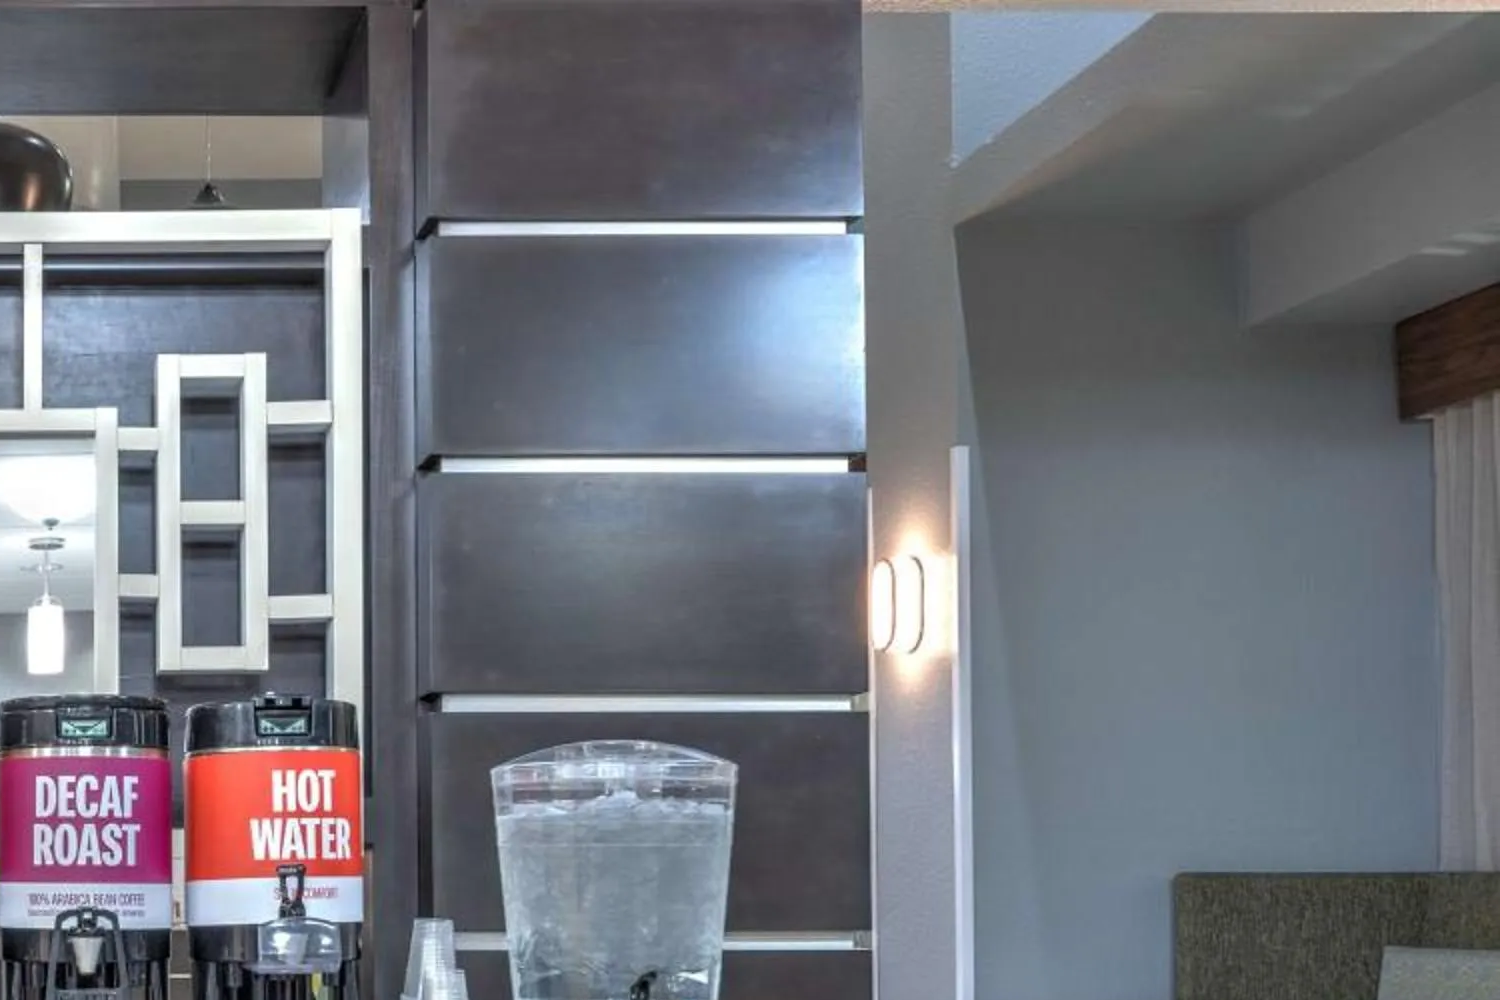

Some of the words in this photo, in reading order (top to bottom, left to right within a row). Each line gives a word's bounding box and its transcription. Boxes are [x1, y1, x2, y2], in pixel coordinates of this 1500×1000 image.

[35, 775, 139, 817] DECAF
[271, 769, 336, 812] HOT
[33, 823, 141, 866] ROAST
[250, 818, 352, 860] WATER
